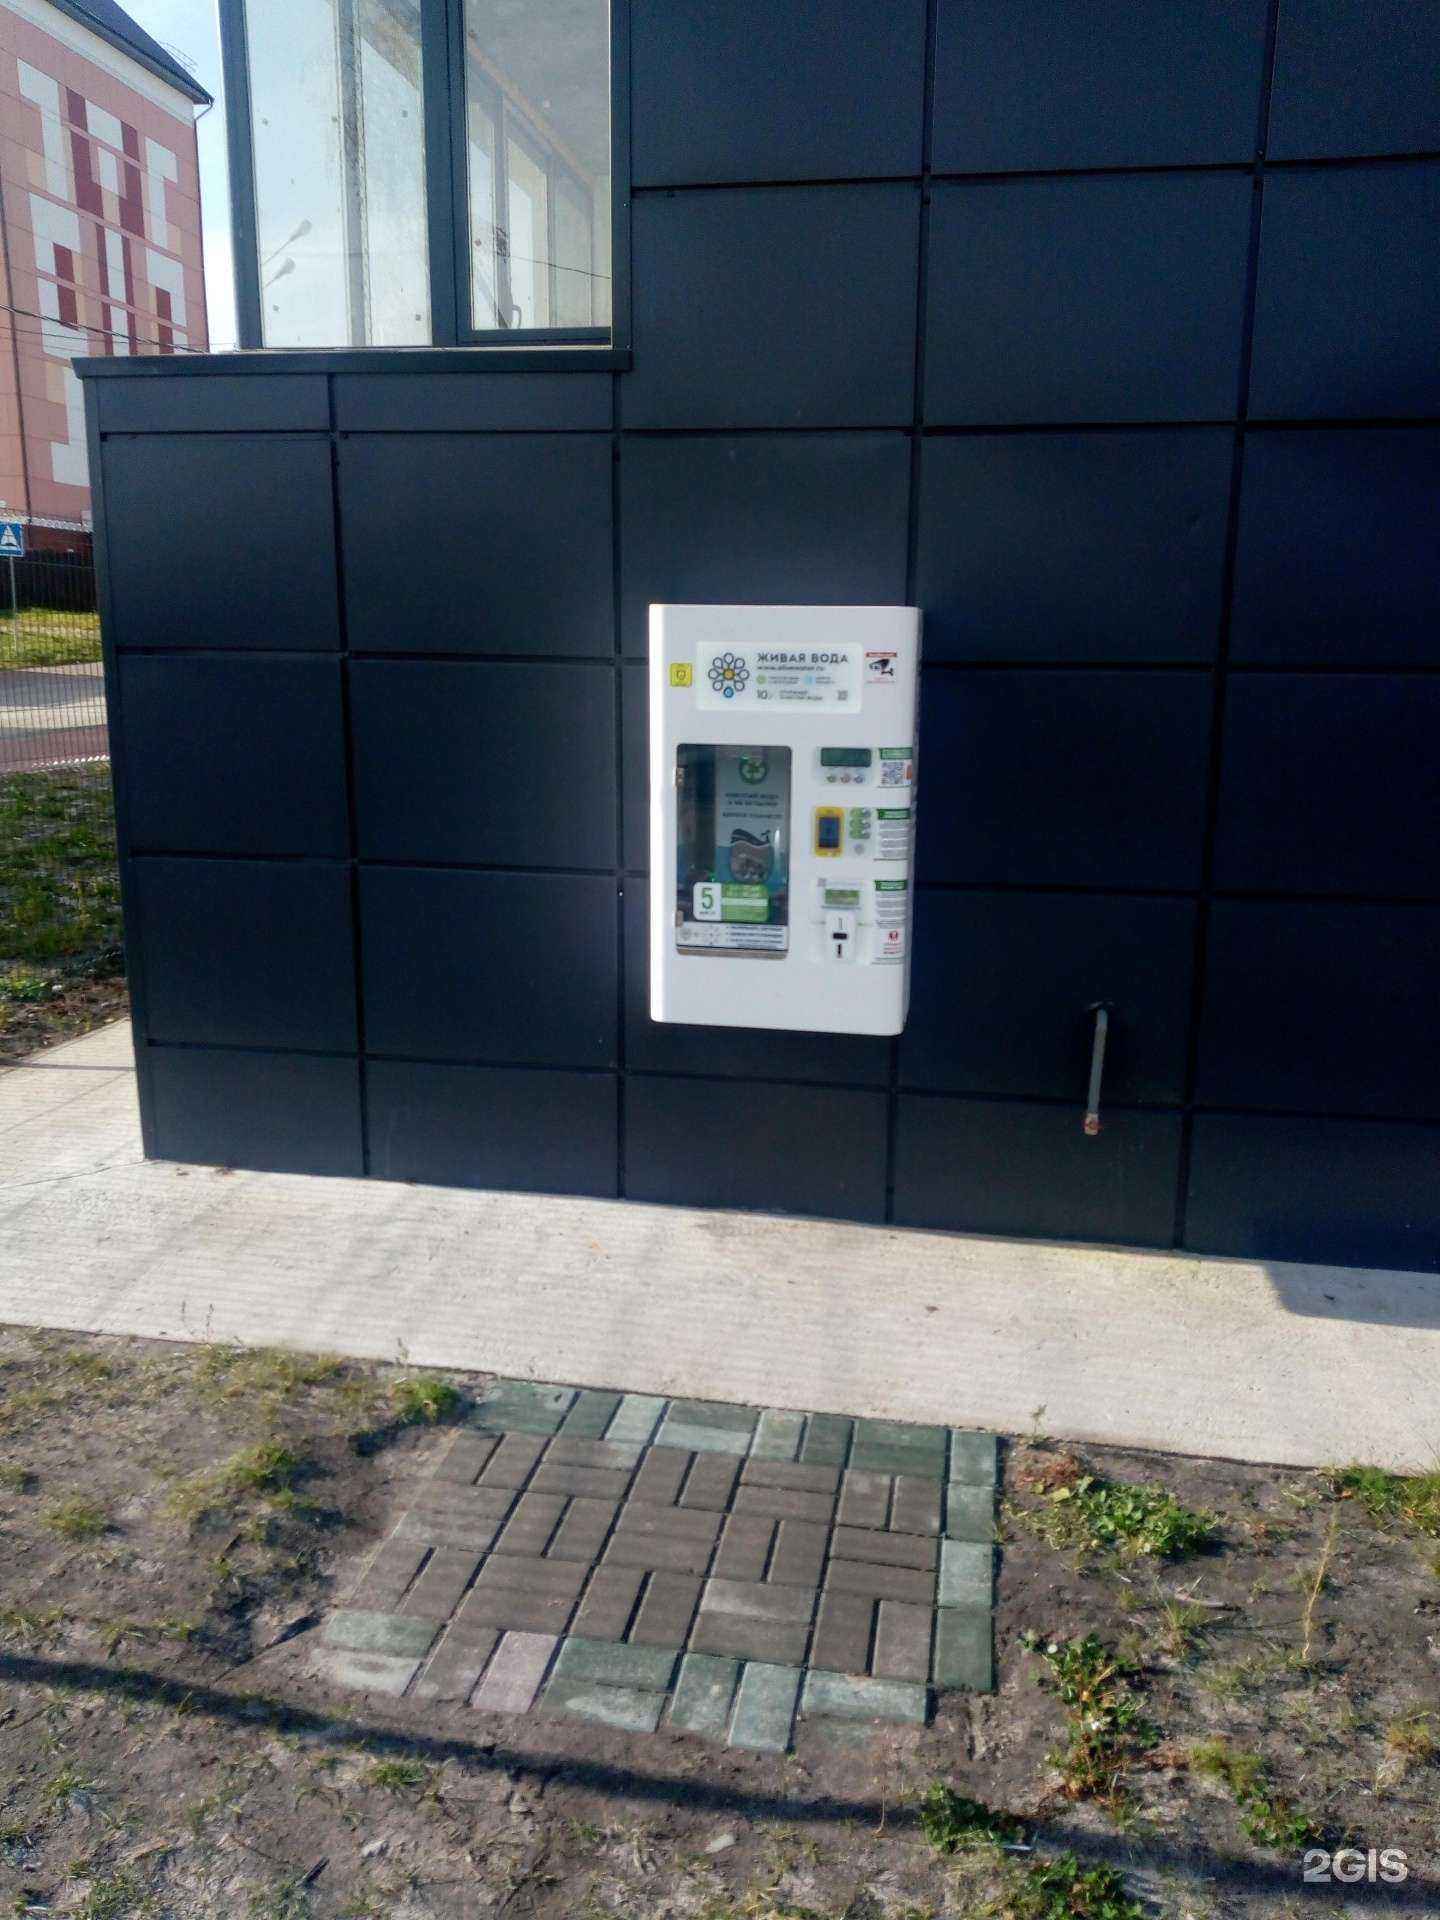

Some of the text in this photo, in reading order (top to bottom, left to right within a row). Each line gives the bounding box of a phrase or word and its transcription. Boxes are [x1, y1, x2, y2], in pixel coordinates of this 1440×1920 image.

[757, 652, 848, 664] ЖИВАЯ ВОДА
[702, 886, 714, 910] 5
